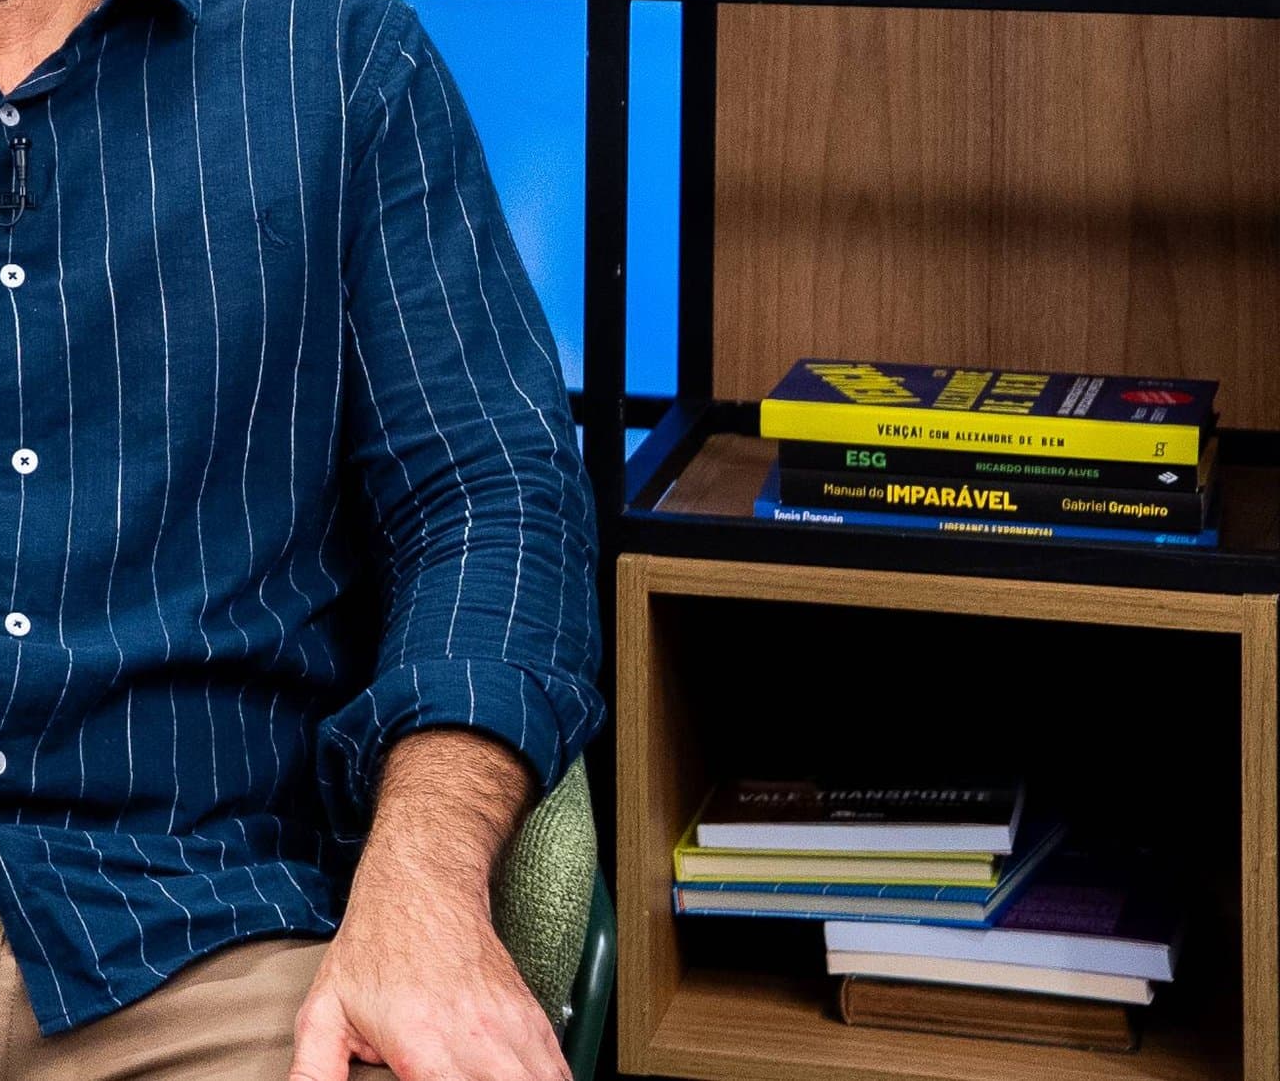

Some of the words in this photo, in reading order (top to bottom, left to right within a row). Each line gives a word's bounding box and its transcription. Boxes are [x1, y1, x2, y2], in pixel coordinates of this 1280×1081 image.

[877, 423, 923, 440] VENÇA!
[928, 428, 950, 440] COM
[955, 430, 1013, 445] ALEXANDRE
[1018, 435, 1033, 446] DE
[1041, 436, 1065, 447] BEM
[845, 450, 887, 468] ESG
[975, 462, 1022, 475] RICARDO
[1024, 465, 1065, 477] RIBEIRO
[1067, 469, 1100, 479] ALVES
[823, 482, 866, 498] Manual
[868, 486, 884, 499] do
[887, 484, 1018, 511] IMPARÁVEL
[1062, 497, 1107, 513] Gabriel
[1108, 500, 1169, 519] Granjeiro
